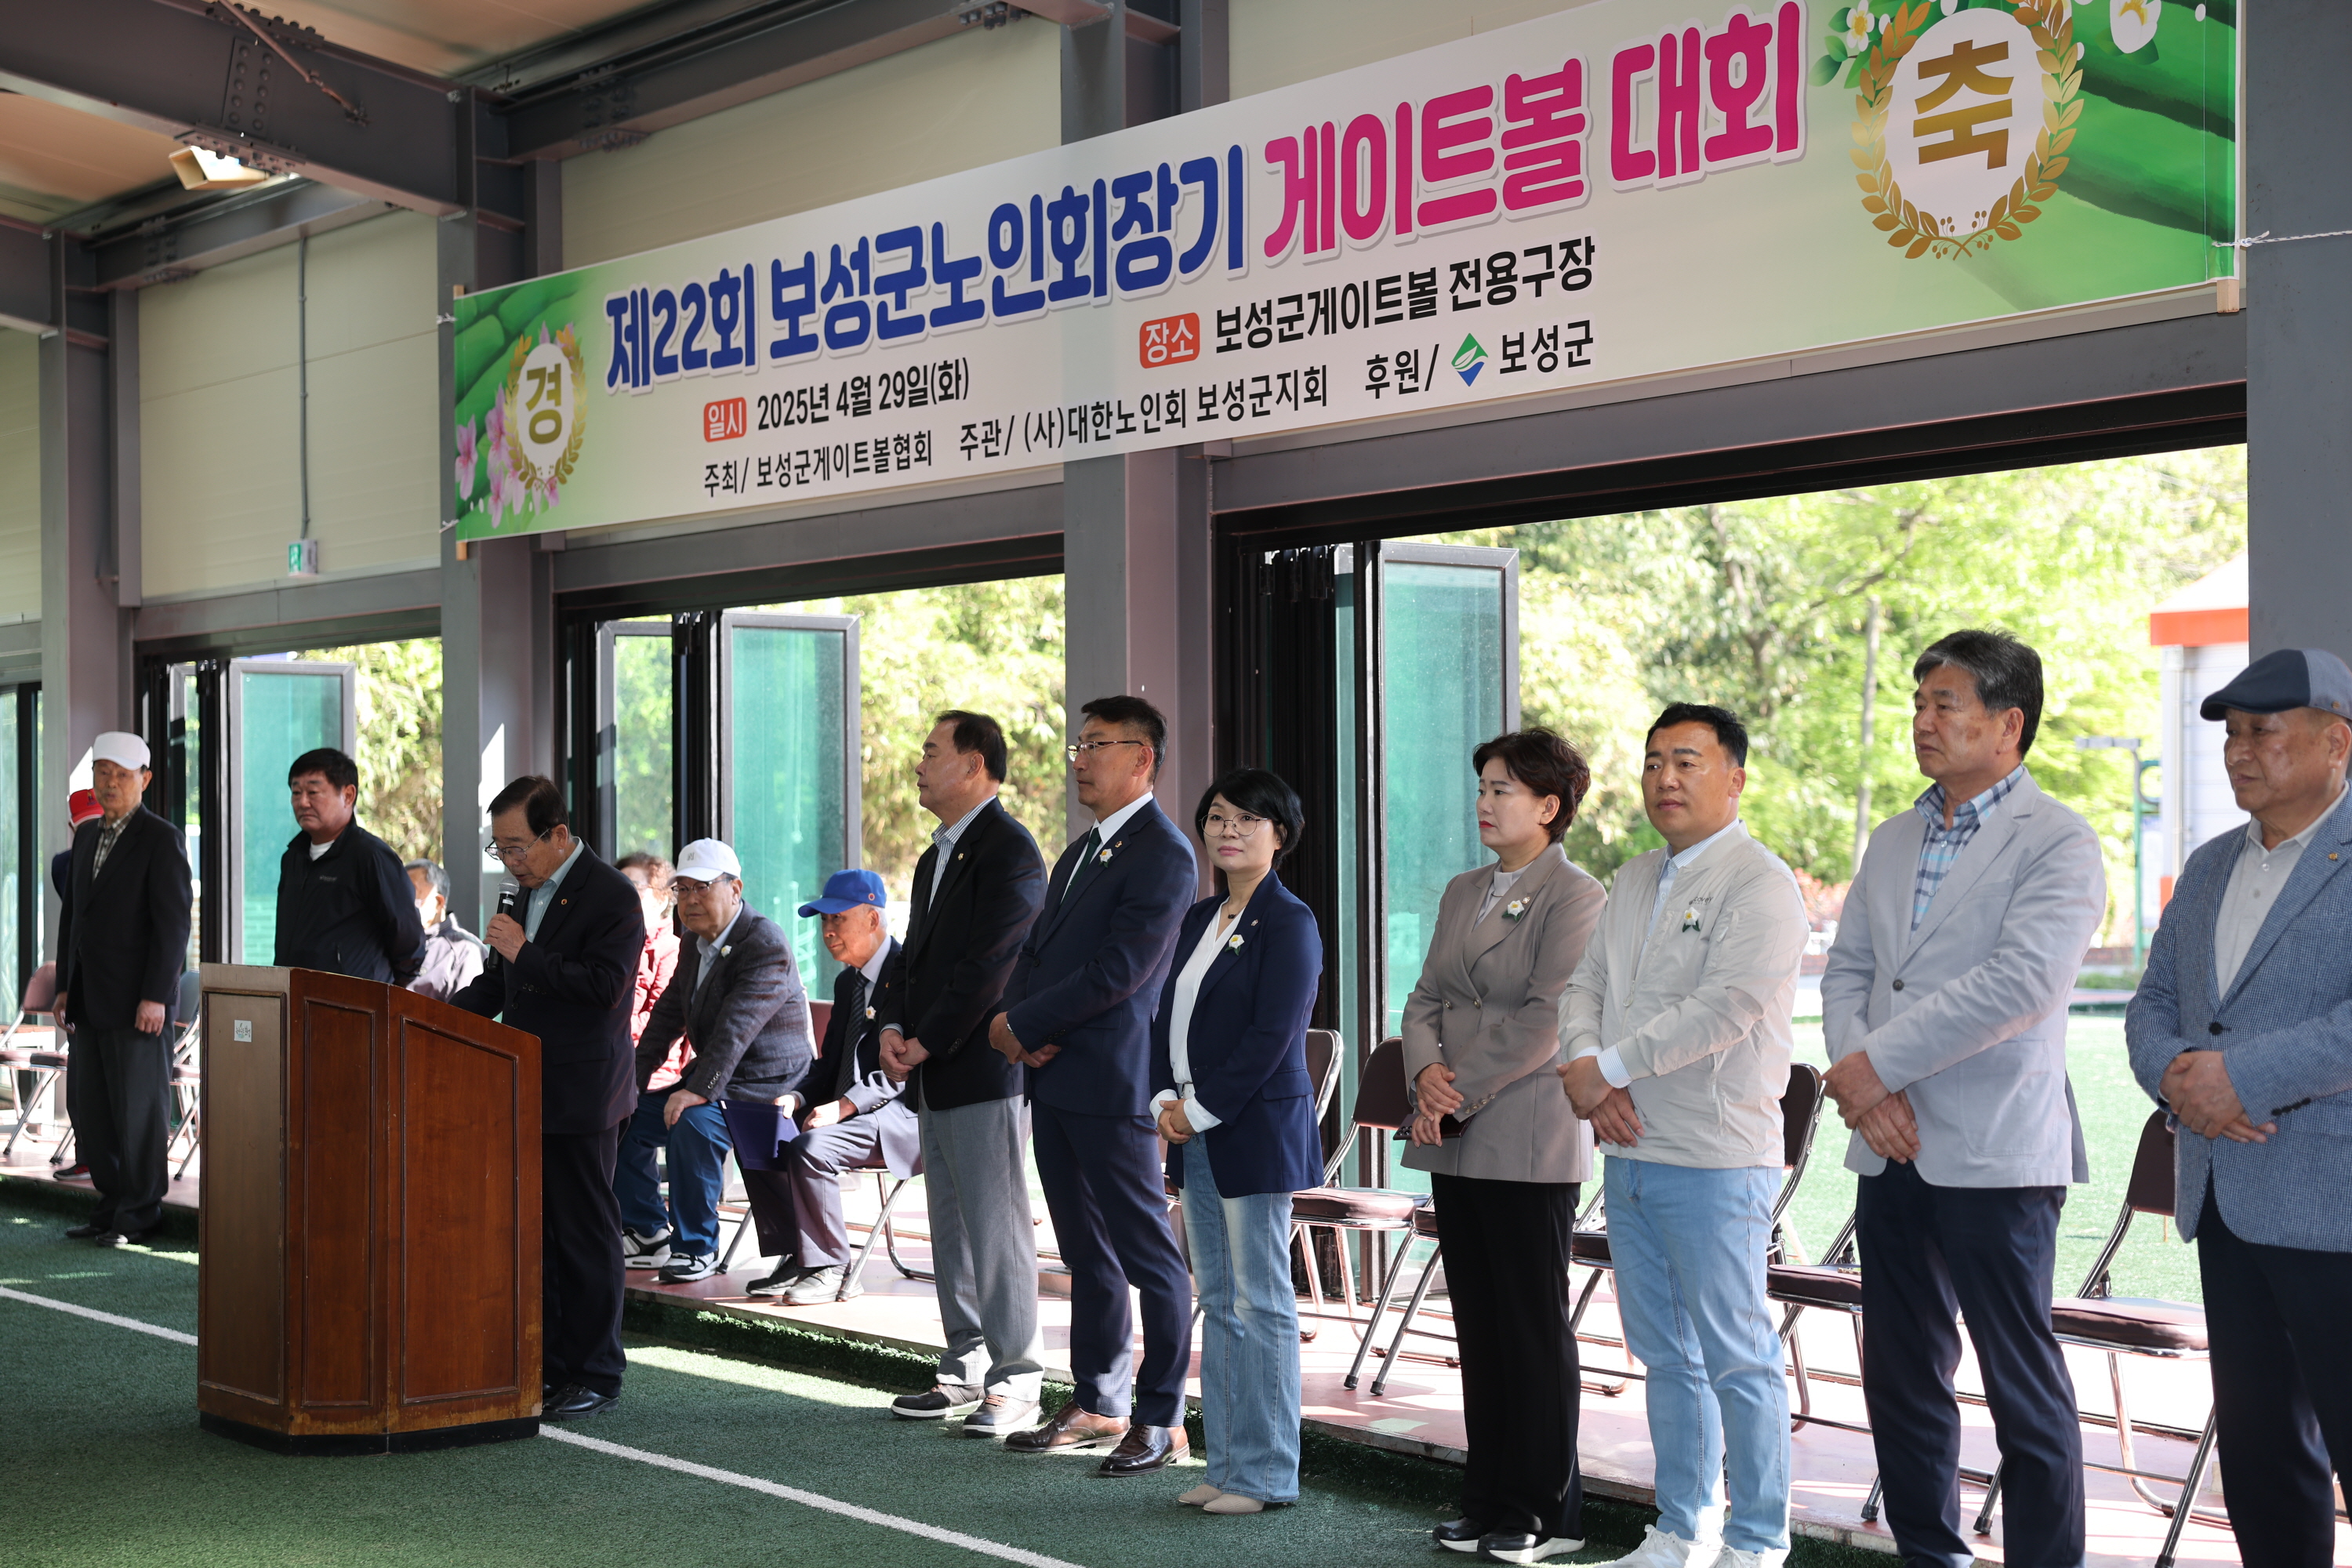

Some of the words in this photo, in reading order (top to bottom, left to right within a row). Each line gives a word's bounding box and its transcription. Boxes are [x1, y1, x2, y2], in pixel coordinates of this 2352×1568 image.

[1913, 39, 2014, 169] 축
[605, 263, 756, 388] 제22회
[770, 144, 1244, 360] 보성군노인회장기
[1264, 58, 1586, 259] 게이트볼
[1610, 1, 1801, 182] 대회
[1145, 318, 1195, 364] 장소
[1215, 267, 1439, 354] 보성군게이트볼
[1449, 235, 1596, 312] 전용구장
[525, 363, 563, 445] 경
[708, 401, 743, 440] 일시
[757, 383, 830, 430] 2025년
[836, 375, 873, 418] 4월
[878, 357, 969, 410] 29일(화)
[1365, 343, 1439, 400] 후원/
[1500, 319, 1594, 375] 보성군
[960, 415, 1015, 461] 주관/
[1023, 388, 1187, 454] (사)대한노인회
[1196, 365, 1327, 422] 보성군지회
[704, 457, 750, 498] 주최/
[757, 430, 932, 488] 보성군게이트볼협회
